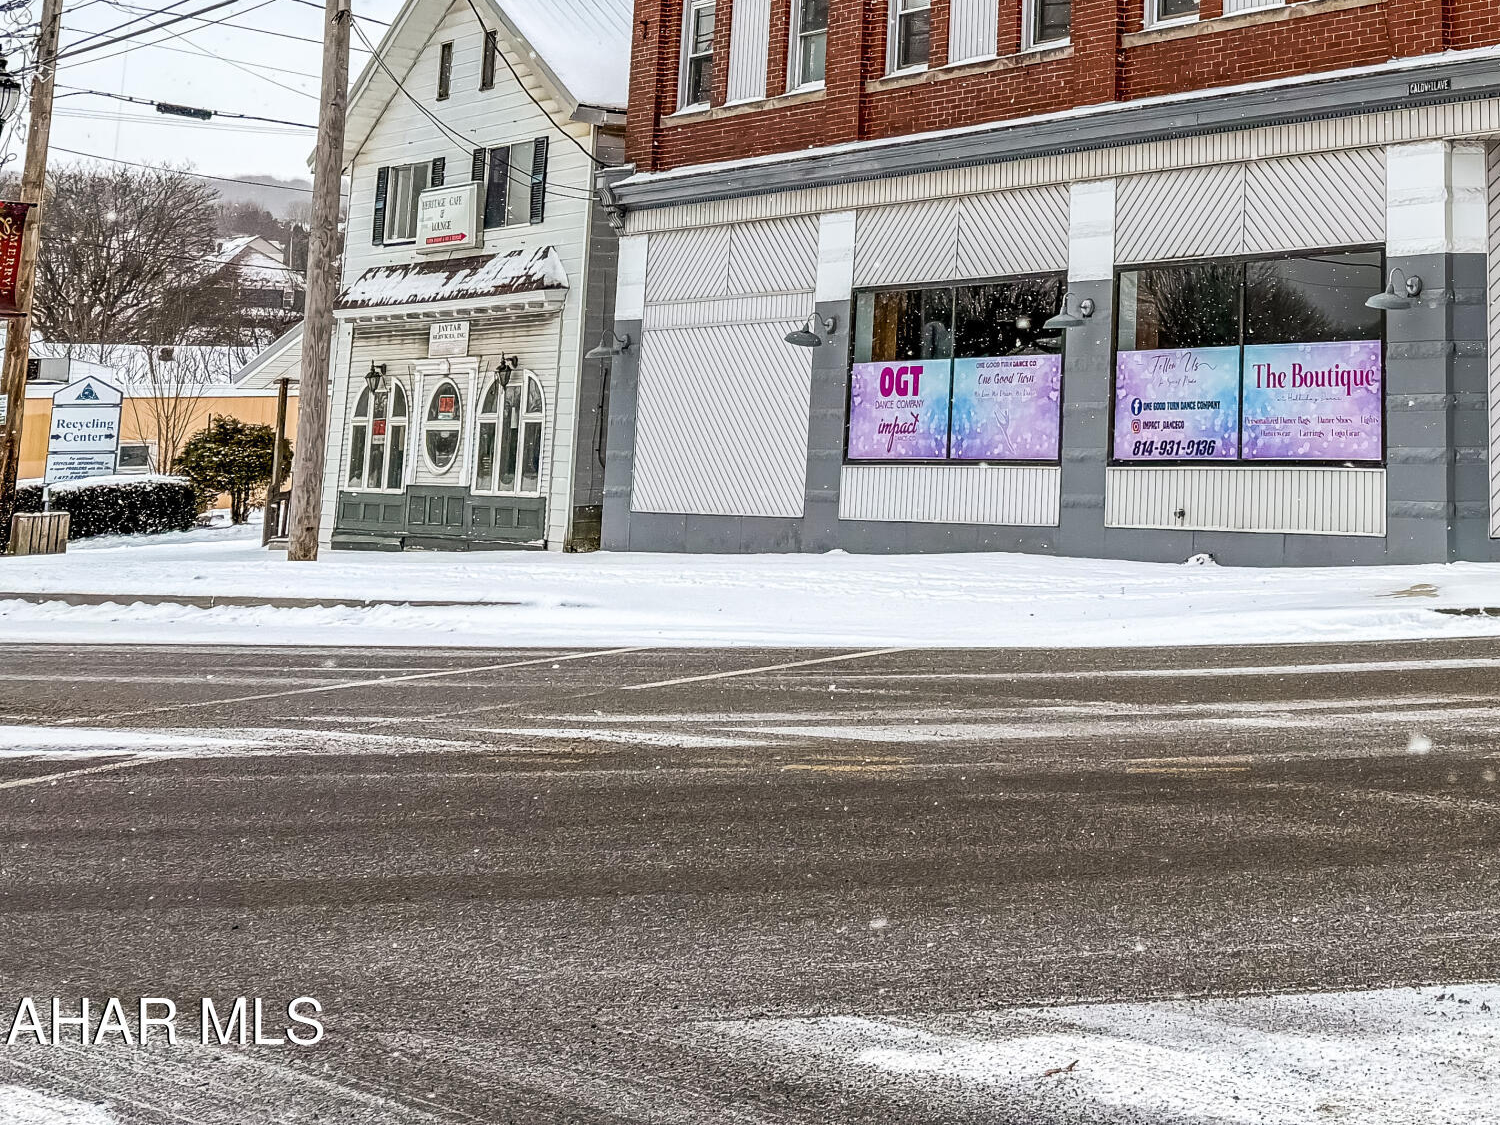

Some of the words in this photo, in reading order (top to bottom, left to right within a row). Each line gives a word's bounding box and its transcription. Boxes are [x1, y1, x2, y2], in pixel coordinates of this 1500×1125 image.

[2, 234, 18, 286] MERRY
[1013, 360, 1028, 368] DANCE
[880, 366, 923, 397] OGT
[993, 373, 1015, 384] Good
[1016, 372, 1034, 384] Turn
[1252, 363, 1287, 388] The
[1292, 363, 1375, 396] Boutique
[875, 400, 894, 410] DANCE
[896, 399, 924, 409] COMPANY
[1143, 402, 1152, 411] ONE
[1153, 402, 1166, 411] GOOD
[1167, 401, 1179, 411] TURN
[1180, 401, 1196, 410] DANCE
[1197, 400, 1220, 410] COMPANY
[56, 418, 114, 431] Recycling
[1298, 415, 1311, 426] Bags
[1335, 416, 1353, 425] Shoes
[63, 432, 104, 442] Center
[878, 411, 919, 453] impact
[1132, 440, 1216, 456] 814-931-9136
